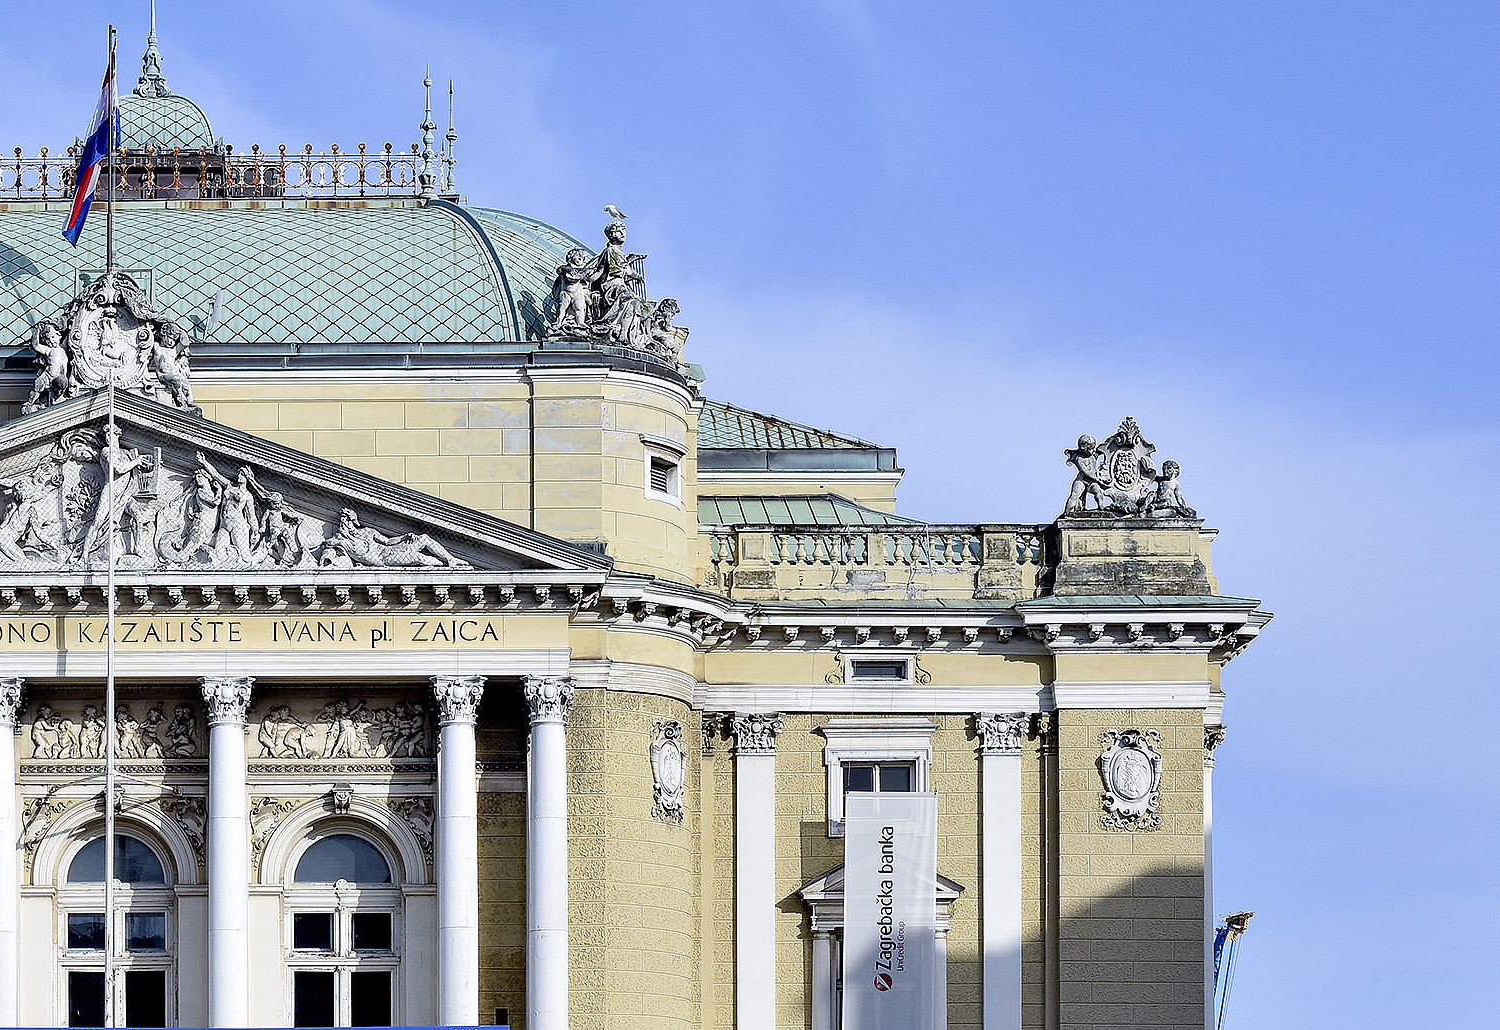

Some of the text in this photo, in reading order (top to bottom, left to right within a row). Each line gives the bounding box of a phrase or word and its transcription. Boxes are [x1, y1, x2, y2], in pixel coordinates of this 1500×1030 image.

[78, 616, 243, 643] KAZALIŠTE
[271, 620, 358, 644] IVANA
[370, 619, 393, 649] pl.
[409, 619, 500, 645] ZAJCA
[875, 825, 896, 971] Zagrebačka banka
[896, 920, 906, 972] UniCredit Group
